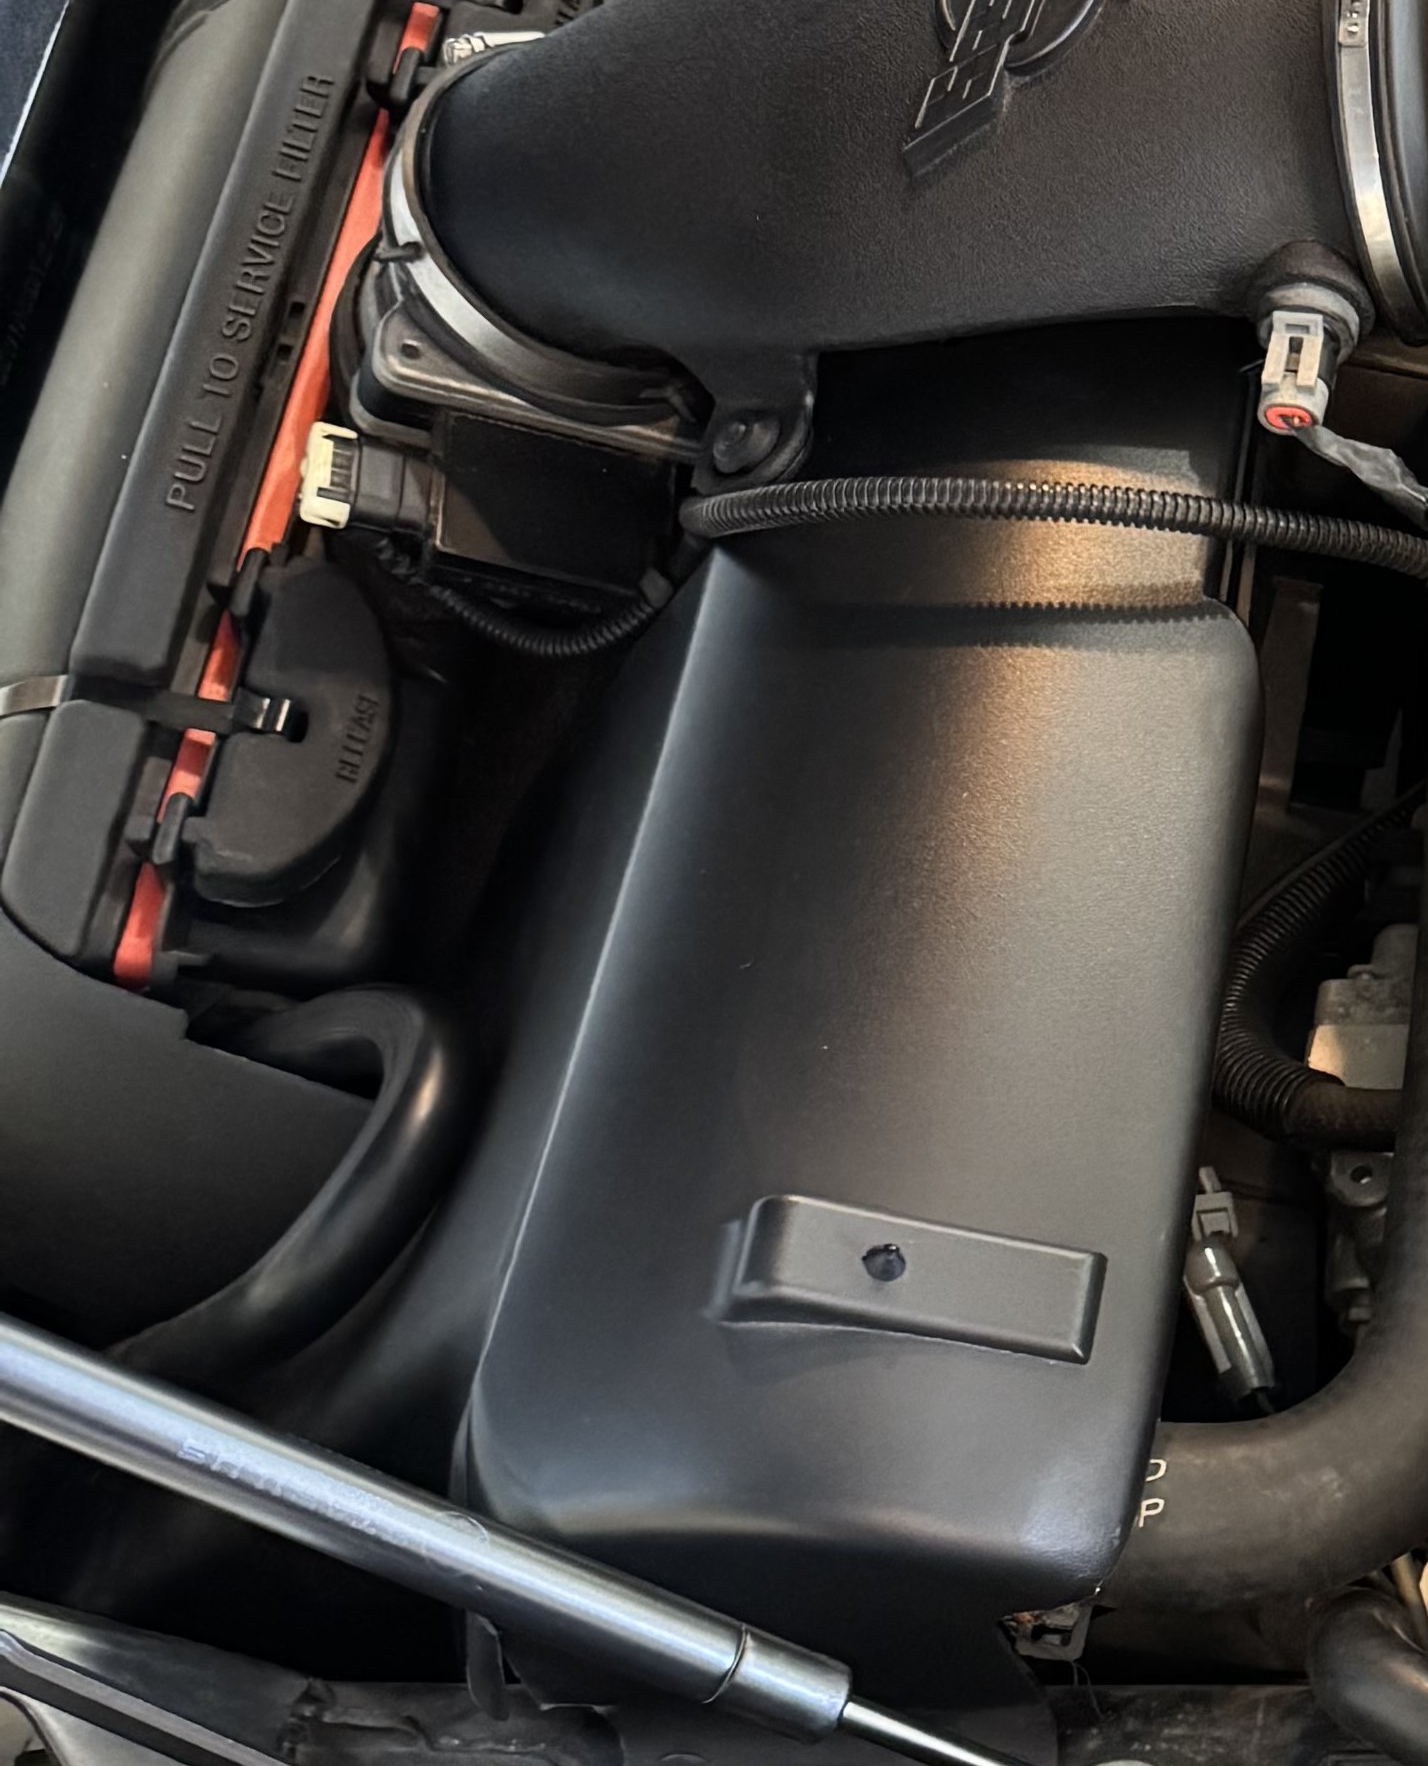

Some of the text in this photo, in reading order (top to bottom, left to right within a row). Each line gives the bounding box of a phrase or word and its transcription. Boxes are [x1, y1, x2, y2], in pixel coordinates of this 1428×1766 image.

[166, 73, 335, 512] PULL TO SERVICE FILTER
